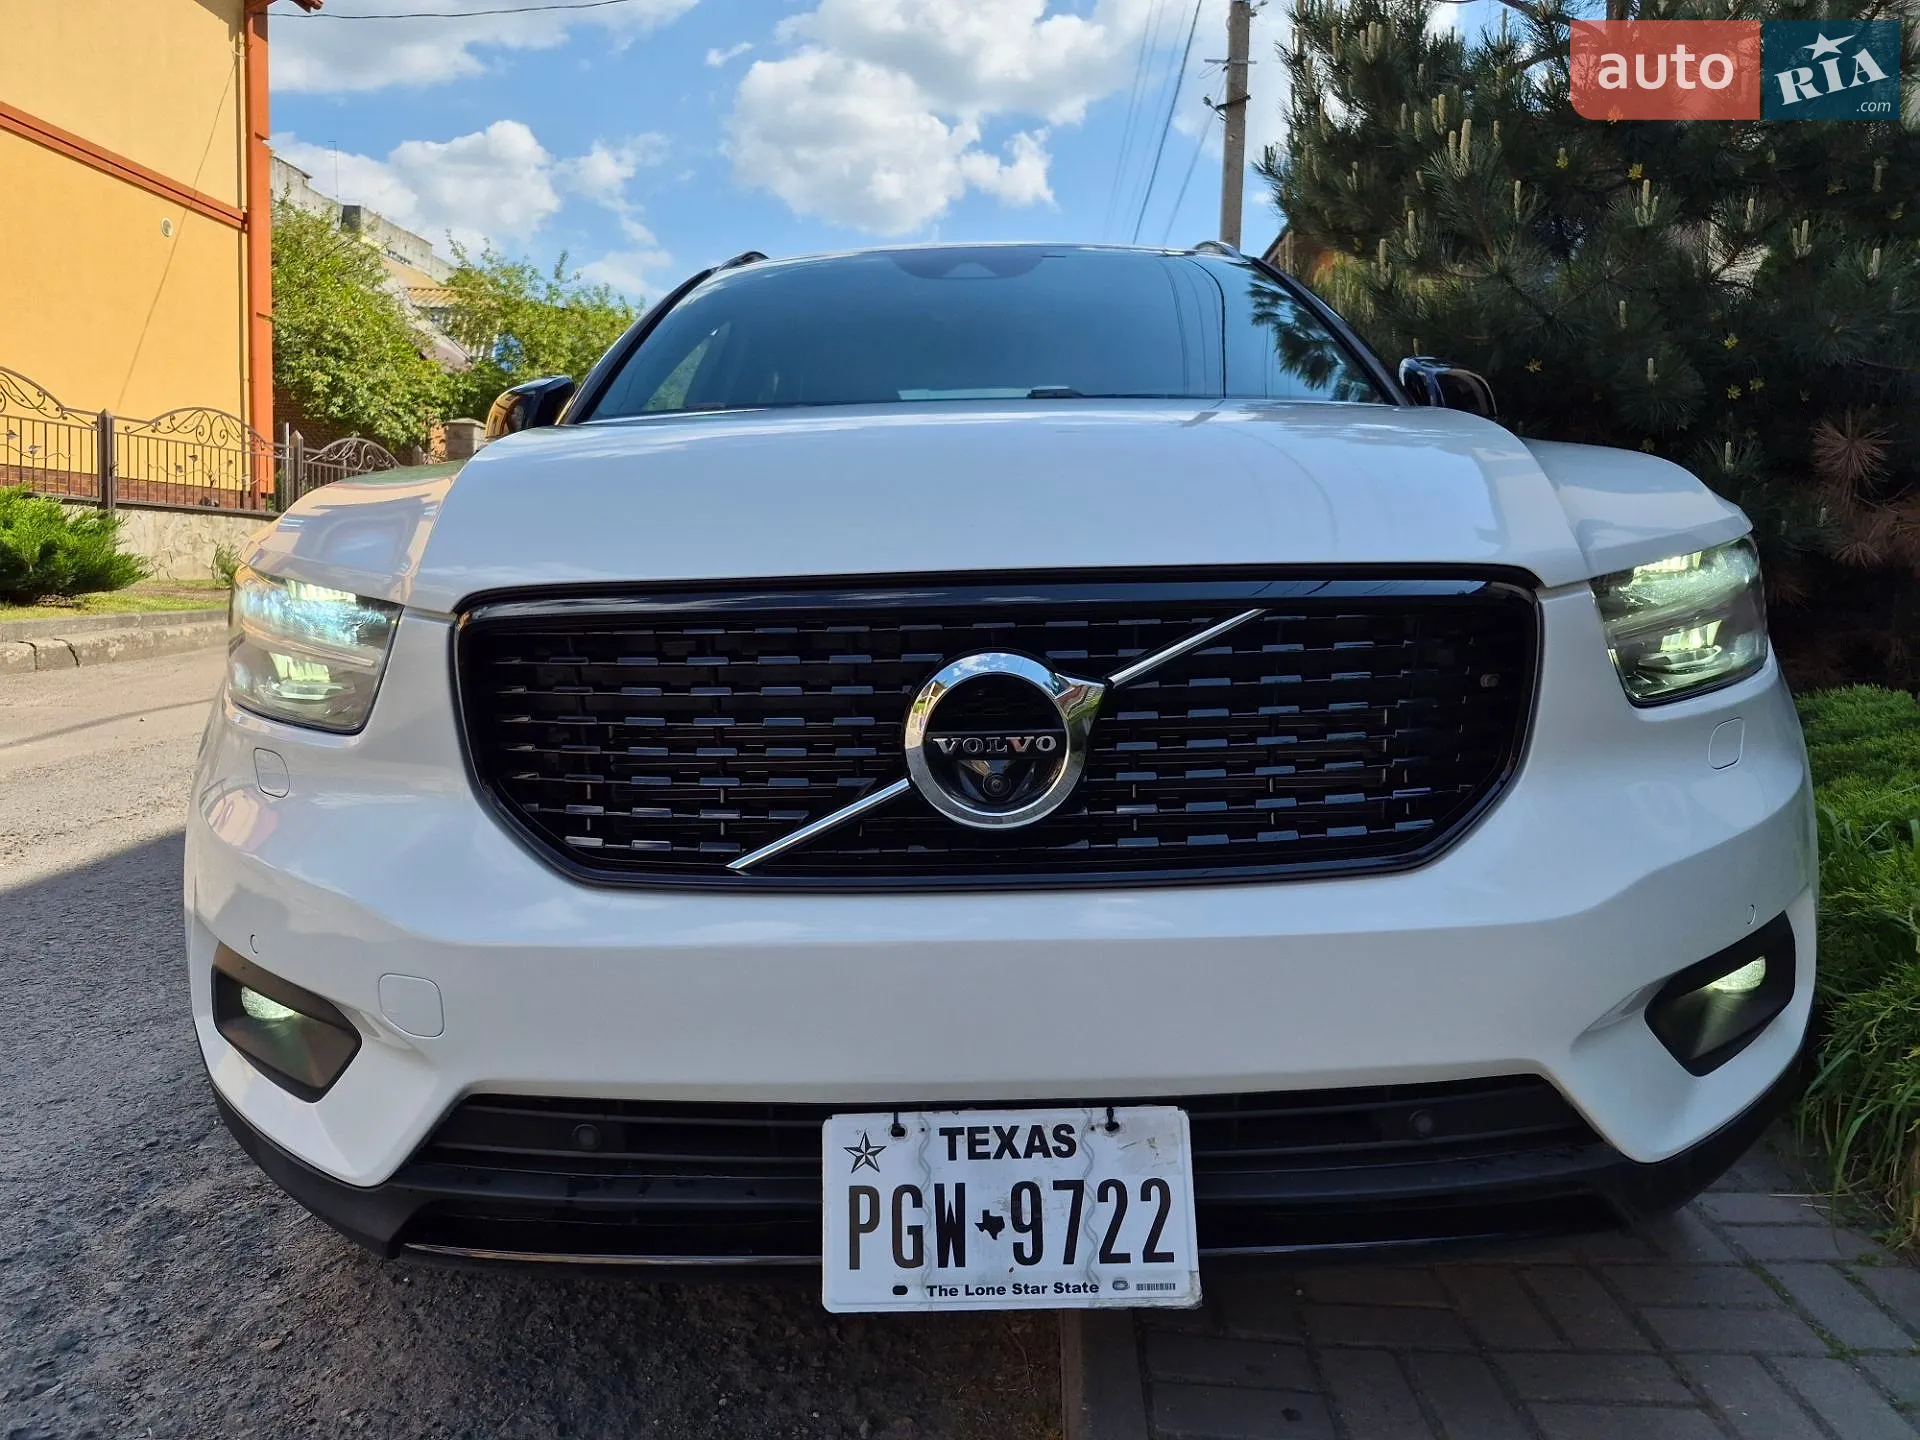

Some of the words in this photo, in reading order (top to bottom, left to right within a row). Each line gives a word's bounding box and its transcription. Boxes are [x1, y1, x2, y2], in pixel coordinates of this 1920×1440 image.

[932, 735, 1057, 754] VOLVO
[939, 1124, 1078, 1161] TEXAS
[848, 1182, 966, 1270] PGW
[1010, 1177, 1175, 1266] 9722
[927, 1285, 961, 1298] The
[965, 1284, 1007, 1297] Lone
[1012, 1283, 1049, 1296] Star
[1054, 1281, 1100, 1295] State
